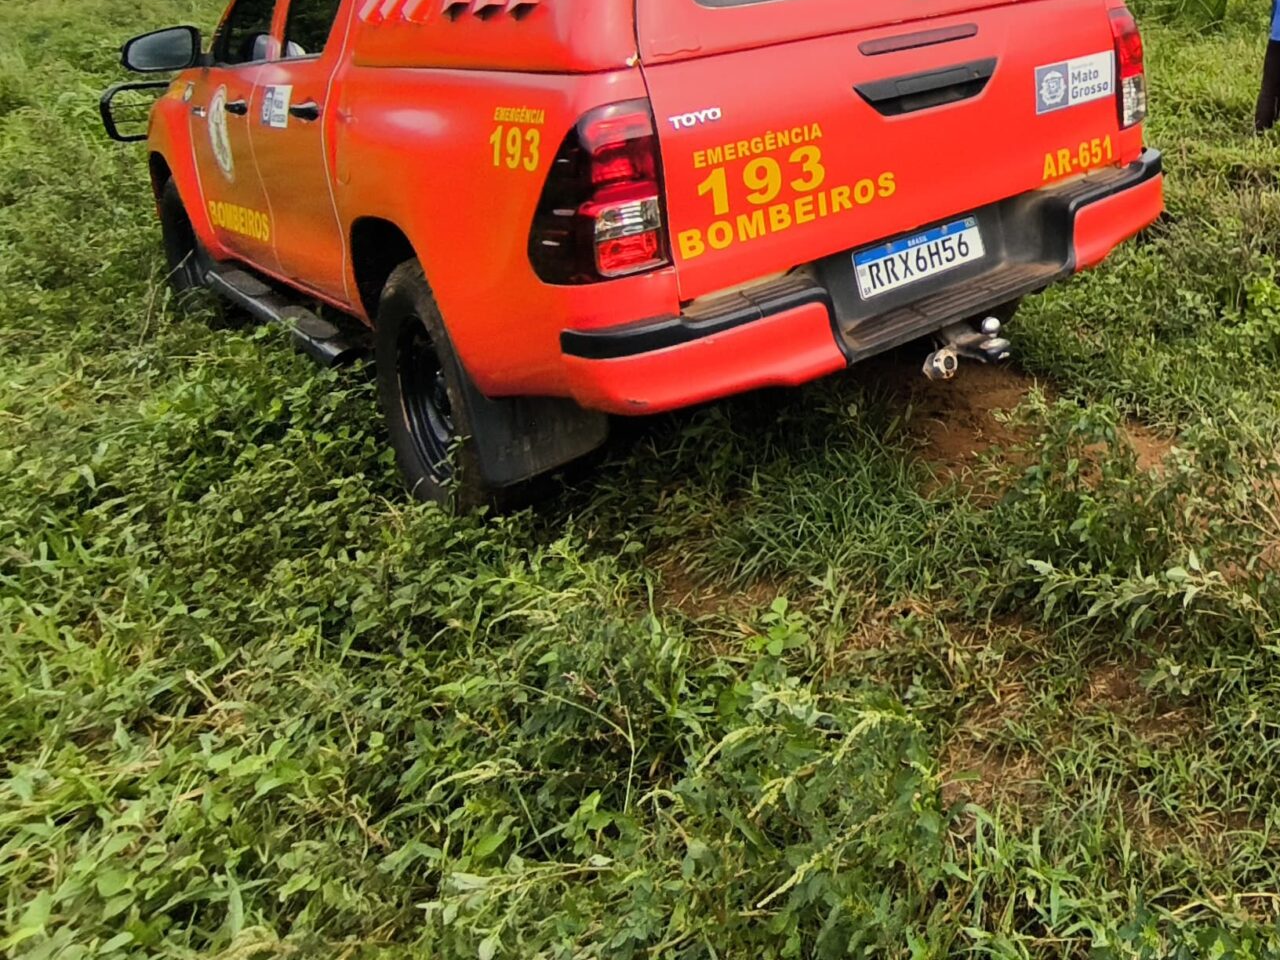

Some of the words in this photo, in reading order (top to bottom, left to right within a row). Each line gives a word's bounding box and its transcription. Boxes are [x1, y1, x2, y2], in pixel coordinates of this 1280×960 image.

[1071, 69, 1099, 85] Mato
[1071, 81, 1109, 99] Grosso
[669, 107, 722, 130] TOYO
[490, 125, 540, 172] 193
[693, 123, 823, 169] EMERGÊNCIA
[1042, 134, 1113, 181] AR-651
[697, 145, 826, 216] 193
[208, 201, 270, 241] BOMBEIROS
[678, 171, 897, 260] BOMBEIROS
[868, 233, 970, 290] RRX6H56
[907, 235, 928, 247] BRASIL
